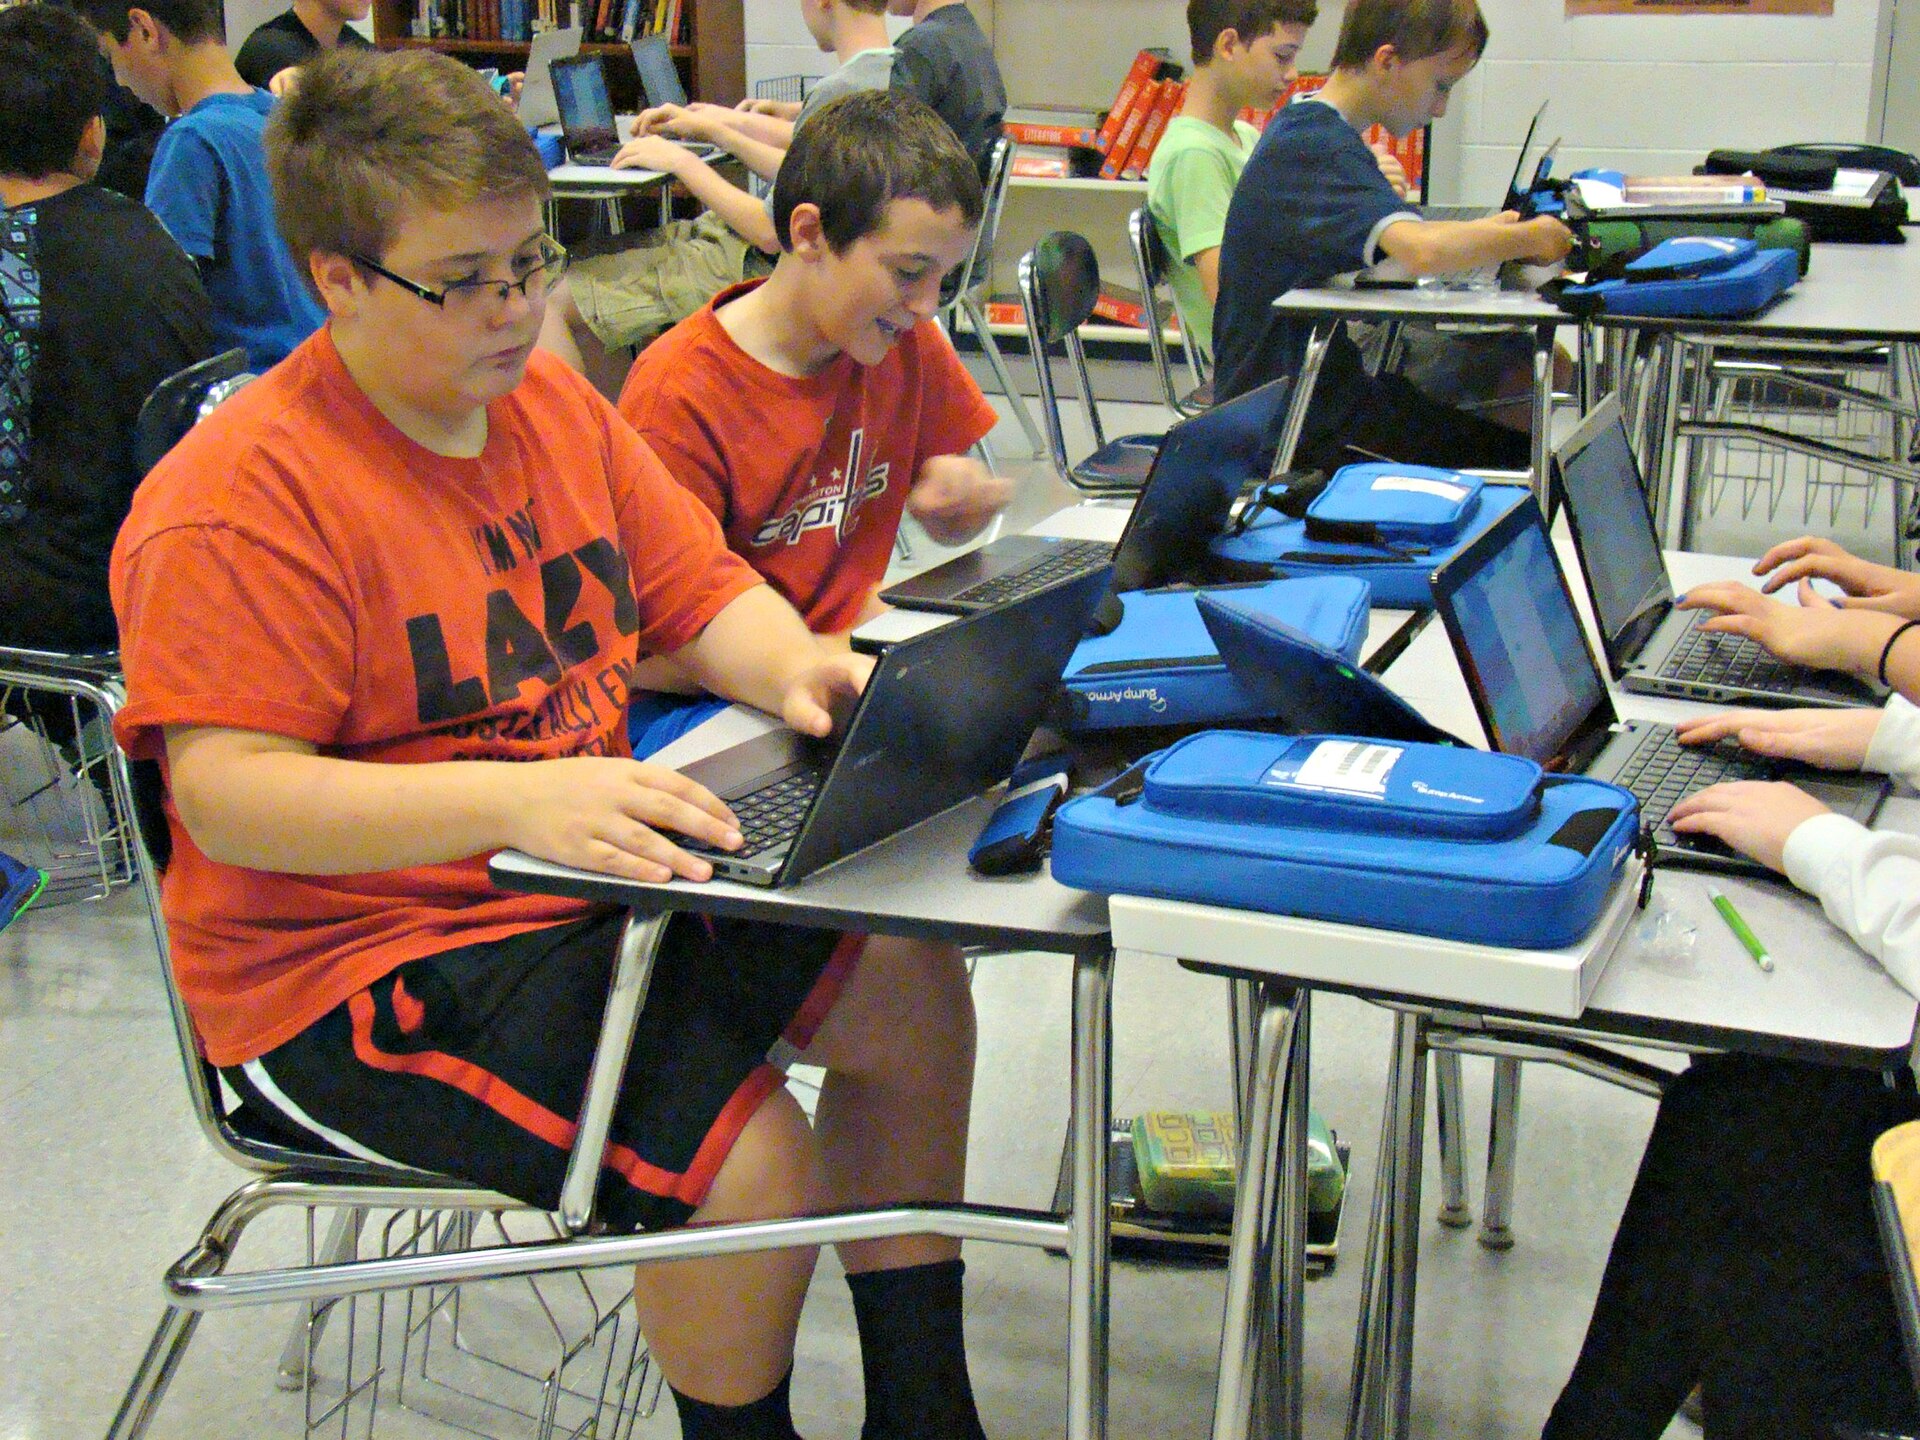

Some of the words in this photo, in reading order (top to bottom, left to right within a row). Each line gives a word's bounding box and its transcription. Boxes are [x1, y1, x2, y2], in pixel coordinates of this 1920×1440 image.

[406, 536, 639, 724] LAZY
[1087, 690, 1122, 702] Armo
[1123, 687, 1157, 701] Bump
